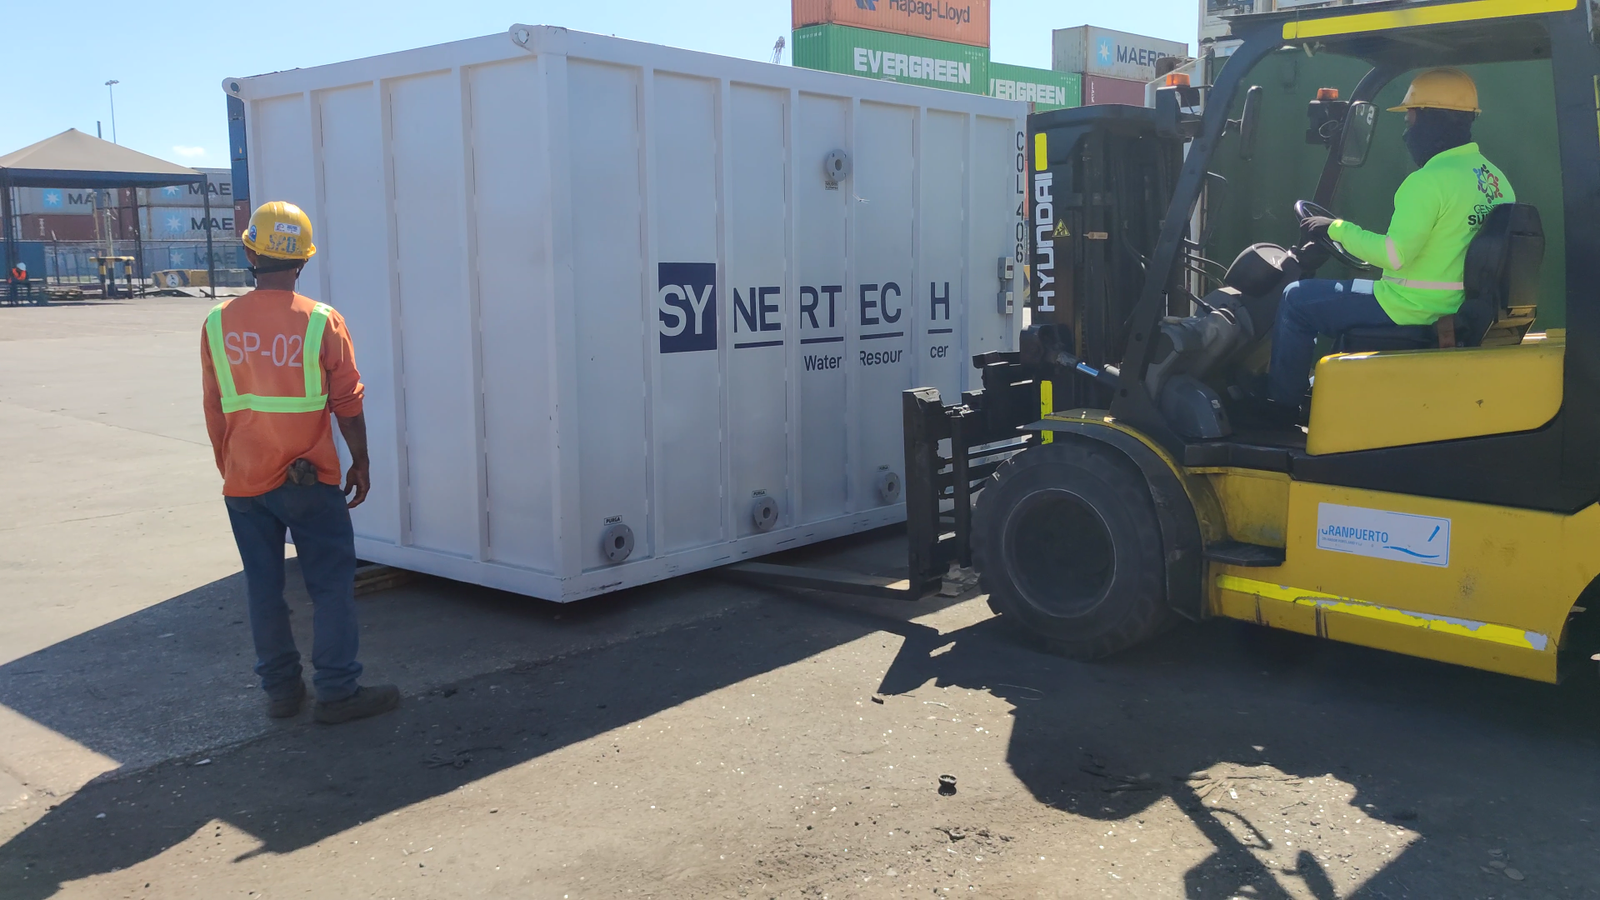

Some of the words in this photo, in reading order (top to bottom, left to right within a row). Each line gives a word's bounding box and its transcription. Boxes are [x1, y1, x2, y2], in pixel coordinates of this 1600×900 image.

[889, 0, 970, 24] Hapag-Lloyd
[854, 47, 971, 84] EVERGREEN
[1117, 44, 1176, 67] MAER
[1016, 131, 1024, 194] COL
[1035, 172, 1055, 312] HYUNDAI
[225, 331, 302, 368] SP-02
[804, 355, 842, 371] Water
